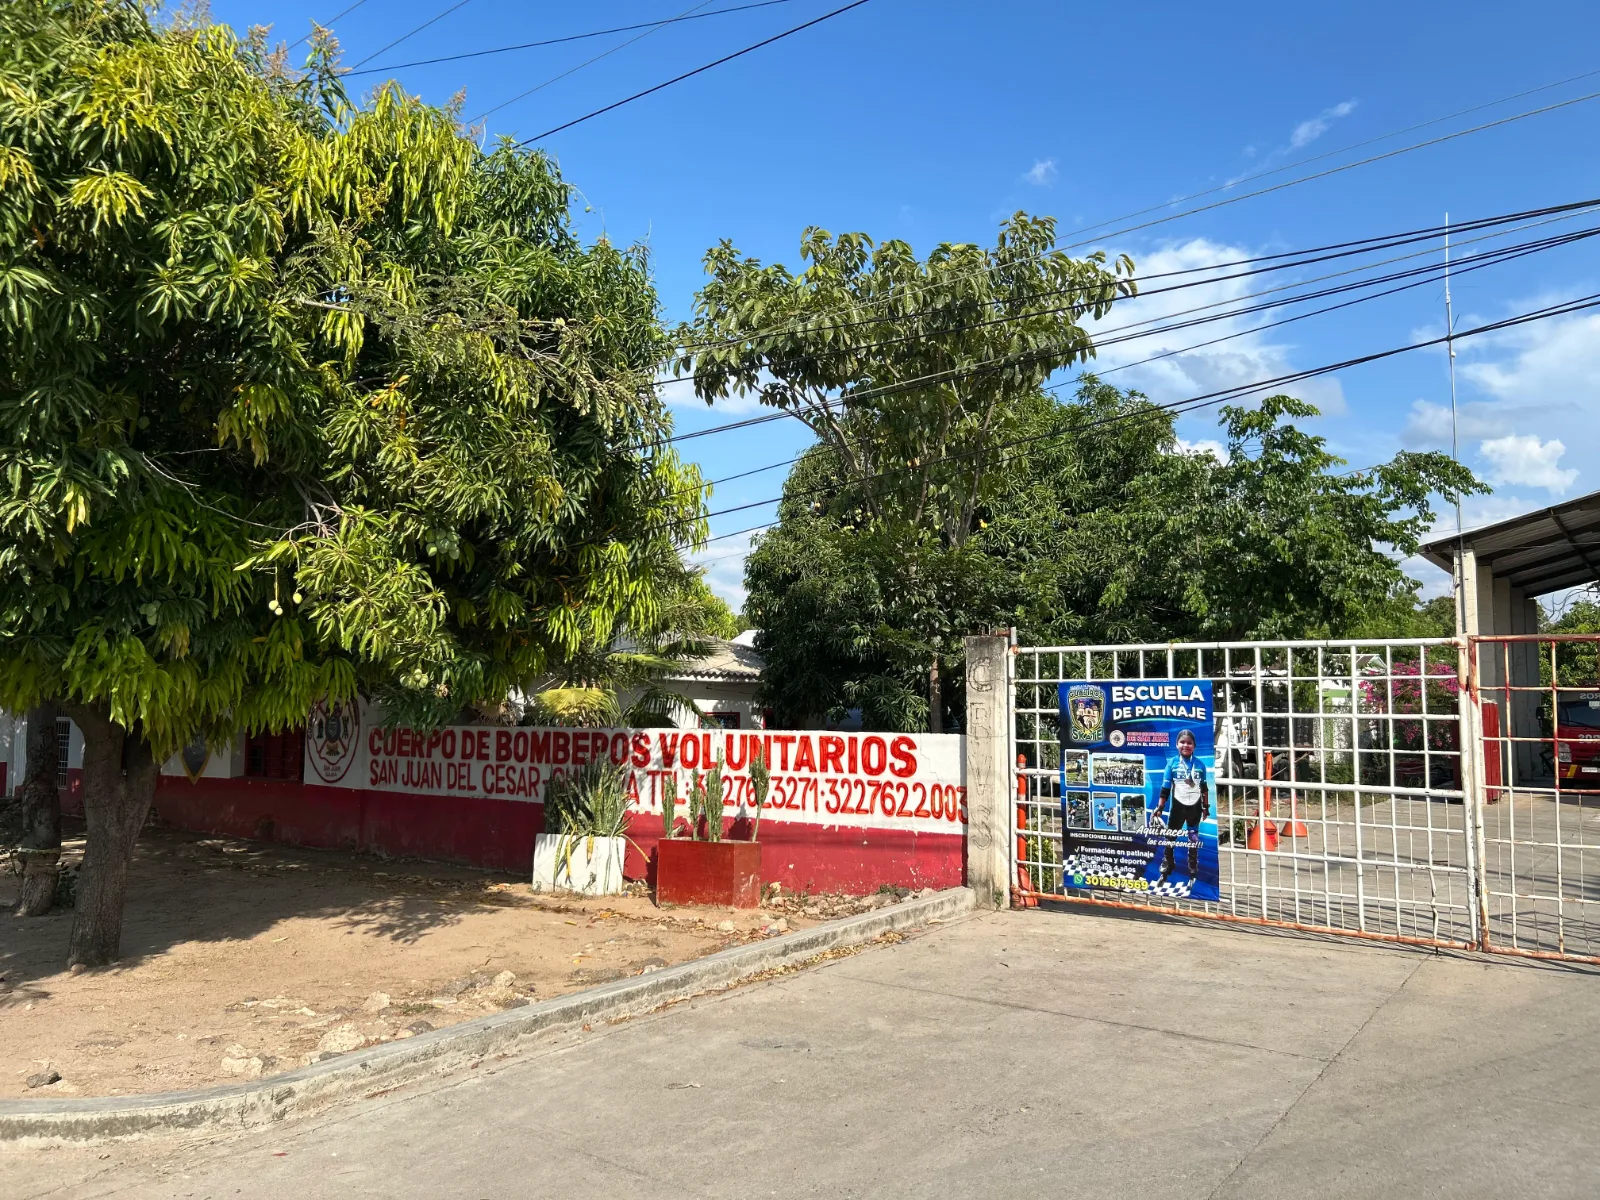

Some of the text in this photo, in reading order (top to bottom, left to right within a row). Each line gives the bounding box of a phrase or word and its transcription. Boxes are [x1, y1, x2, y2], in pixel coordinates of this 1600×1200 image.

[1112, 686, 1205, 702] ESCUELA
[1113, 706, 1207, 720] DE PATINAJE
[1071, 726, 1104, 741] SKATE
[369, 727, 918, 778] CUERPO DE BOMBEROS VOLUNTARIOS
[370, 759, 398, 786] SAN
[402, 760, 441, 789] JUAN
[447, 762, 477, 792] DEL
[1070, 832, 1107, 840] INSCRIPCIONES
[1136, 824, 1189, 837] Aquí nacen
[1158, 839, 1204, 849] campeones!!!
[1080, 846, 1115, 854] Formación
[1126, 849, 1155, 859] patinaje
[1081, 854, 1112, 863] Disciplina
[1120, 857, 1147, 866] deporte
[1102, 863, 1112, 871] los
[1119, 865, 1136, 873] años
[1085, 875, 1149, 890] 3012617569
